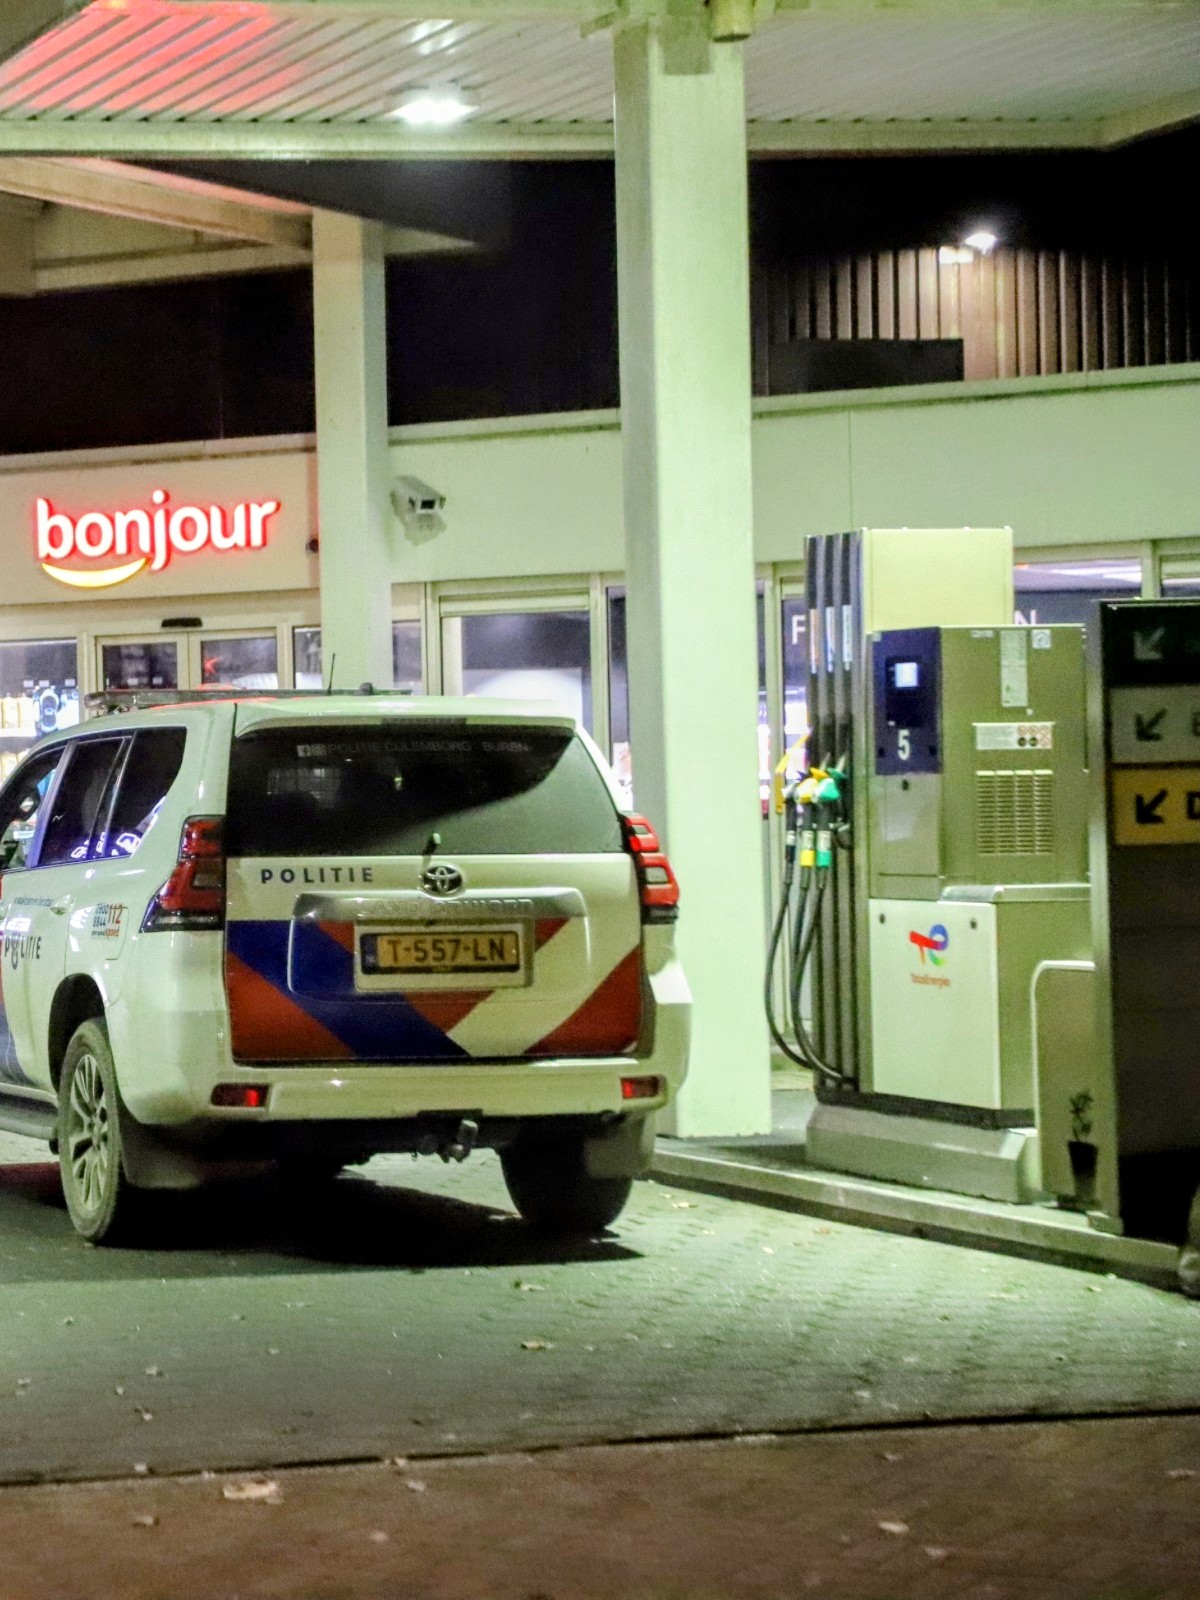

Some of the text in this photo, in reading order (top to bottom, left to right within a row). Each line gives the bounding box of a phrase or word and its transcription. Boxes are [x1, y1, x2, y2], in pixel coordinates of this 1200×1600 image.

[36, 488, 281, 571] bonjour
[897, 728, 911, 761] 5
[261, 866, 373, 884] POLITIE
[108, 904, 123, 924] 112
[4, 936, 41, 970] POLITIE
[386, 937, 505, 964] T-557-LN
